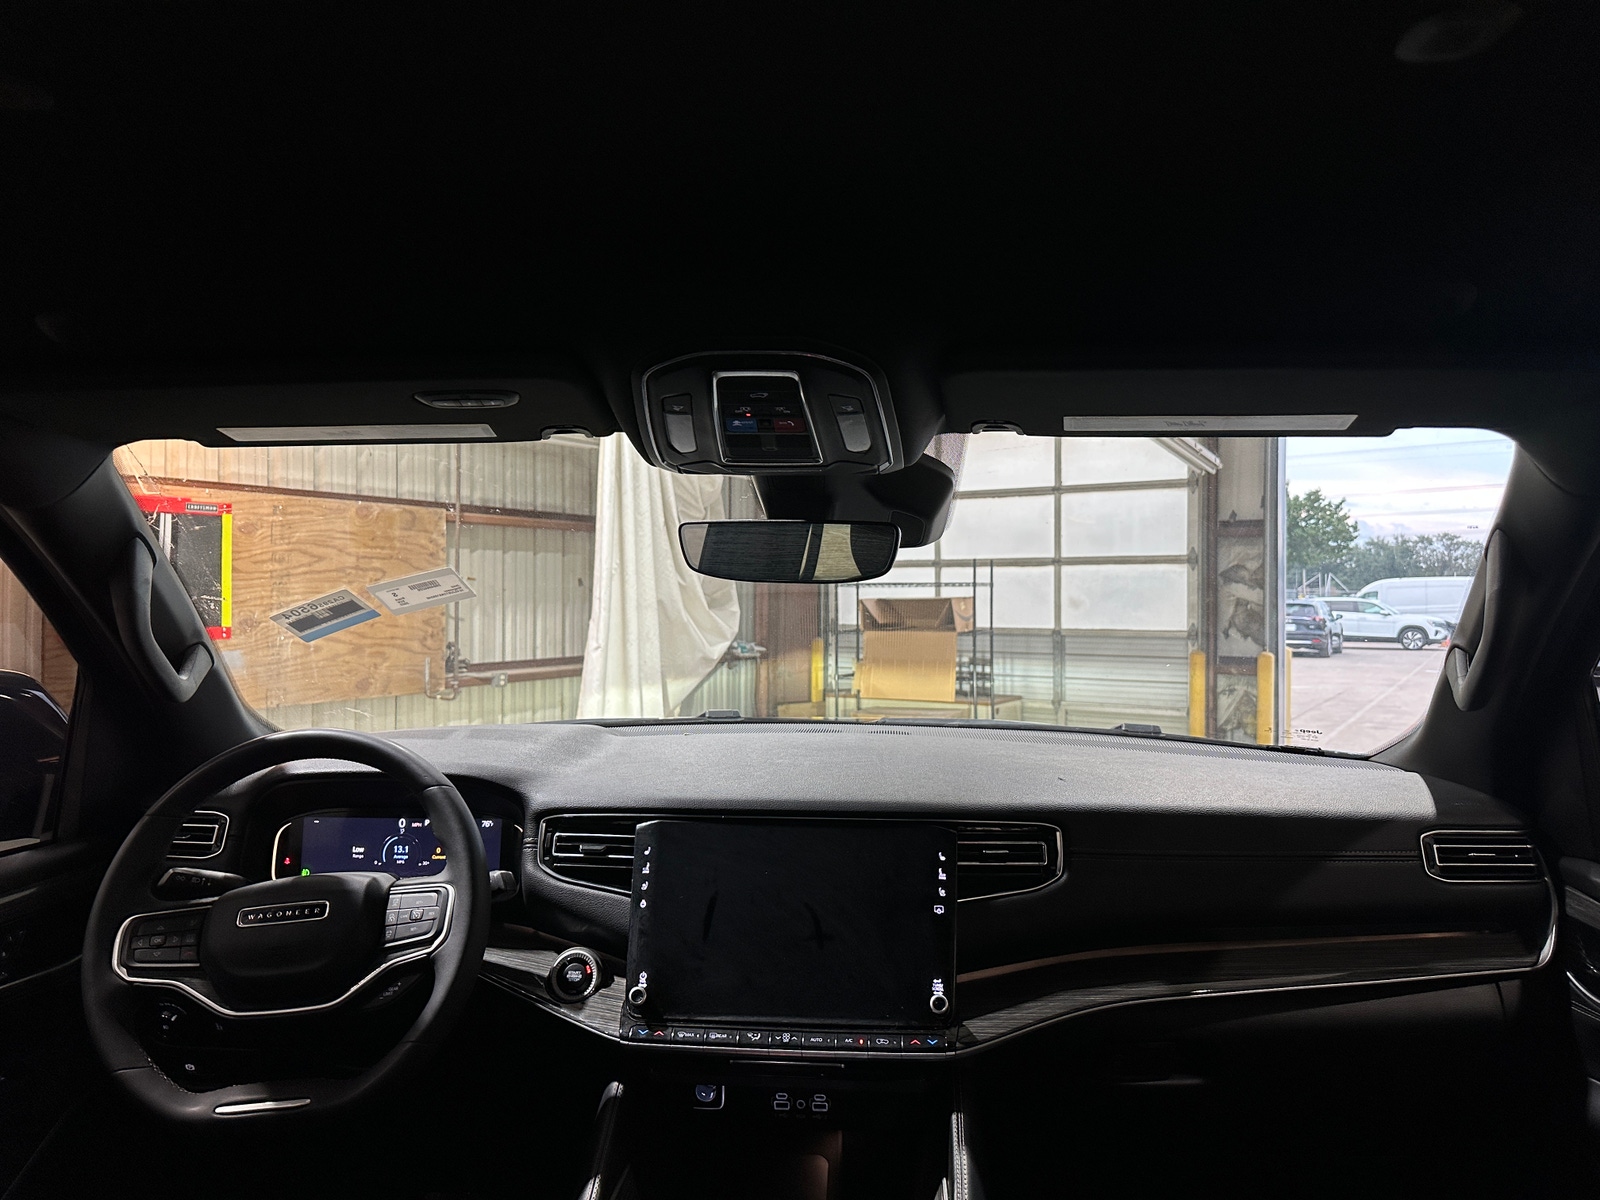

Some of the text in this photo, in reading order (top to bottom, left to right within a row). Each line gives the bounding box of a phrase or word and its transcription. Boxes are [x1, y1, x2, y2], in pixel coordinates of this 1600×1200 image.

[187, 503, 218, 512] CRAFTSMAN
[398, 818, 406, 828] 0
[352, 845, 364, 853] Low
[393, 845, 409, 853] 13.1
[247, 907, 320, 920] WAGONEER
